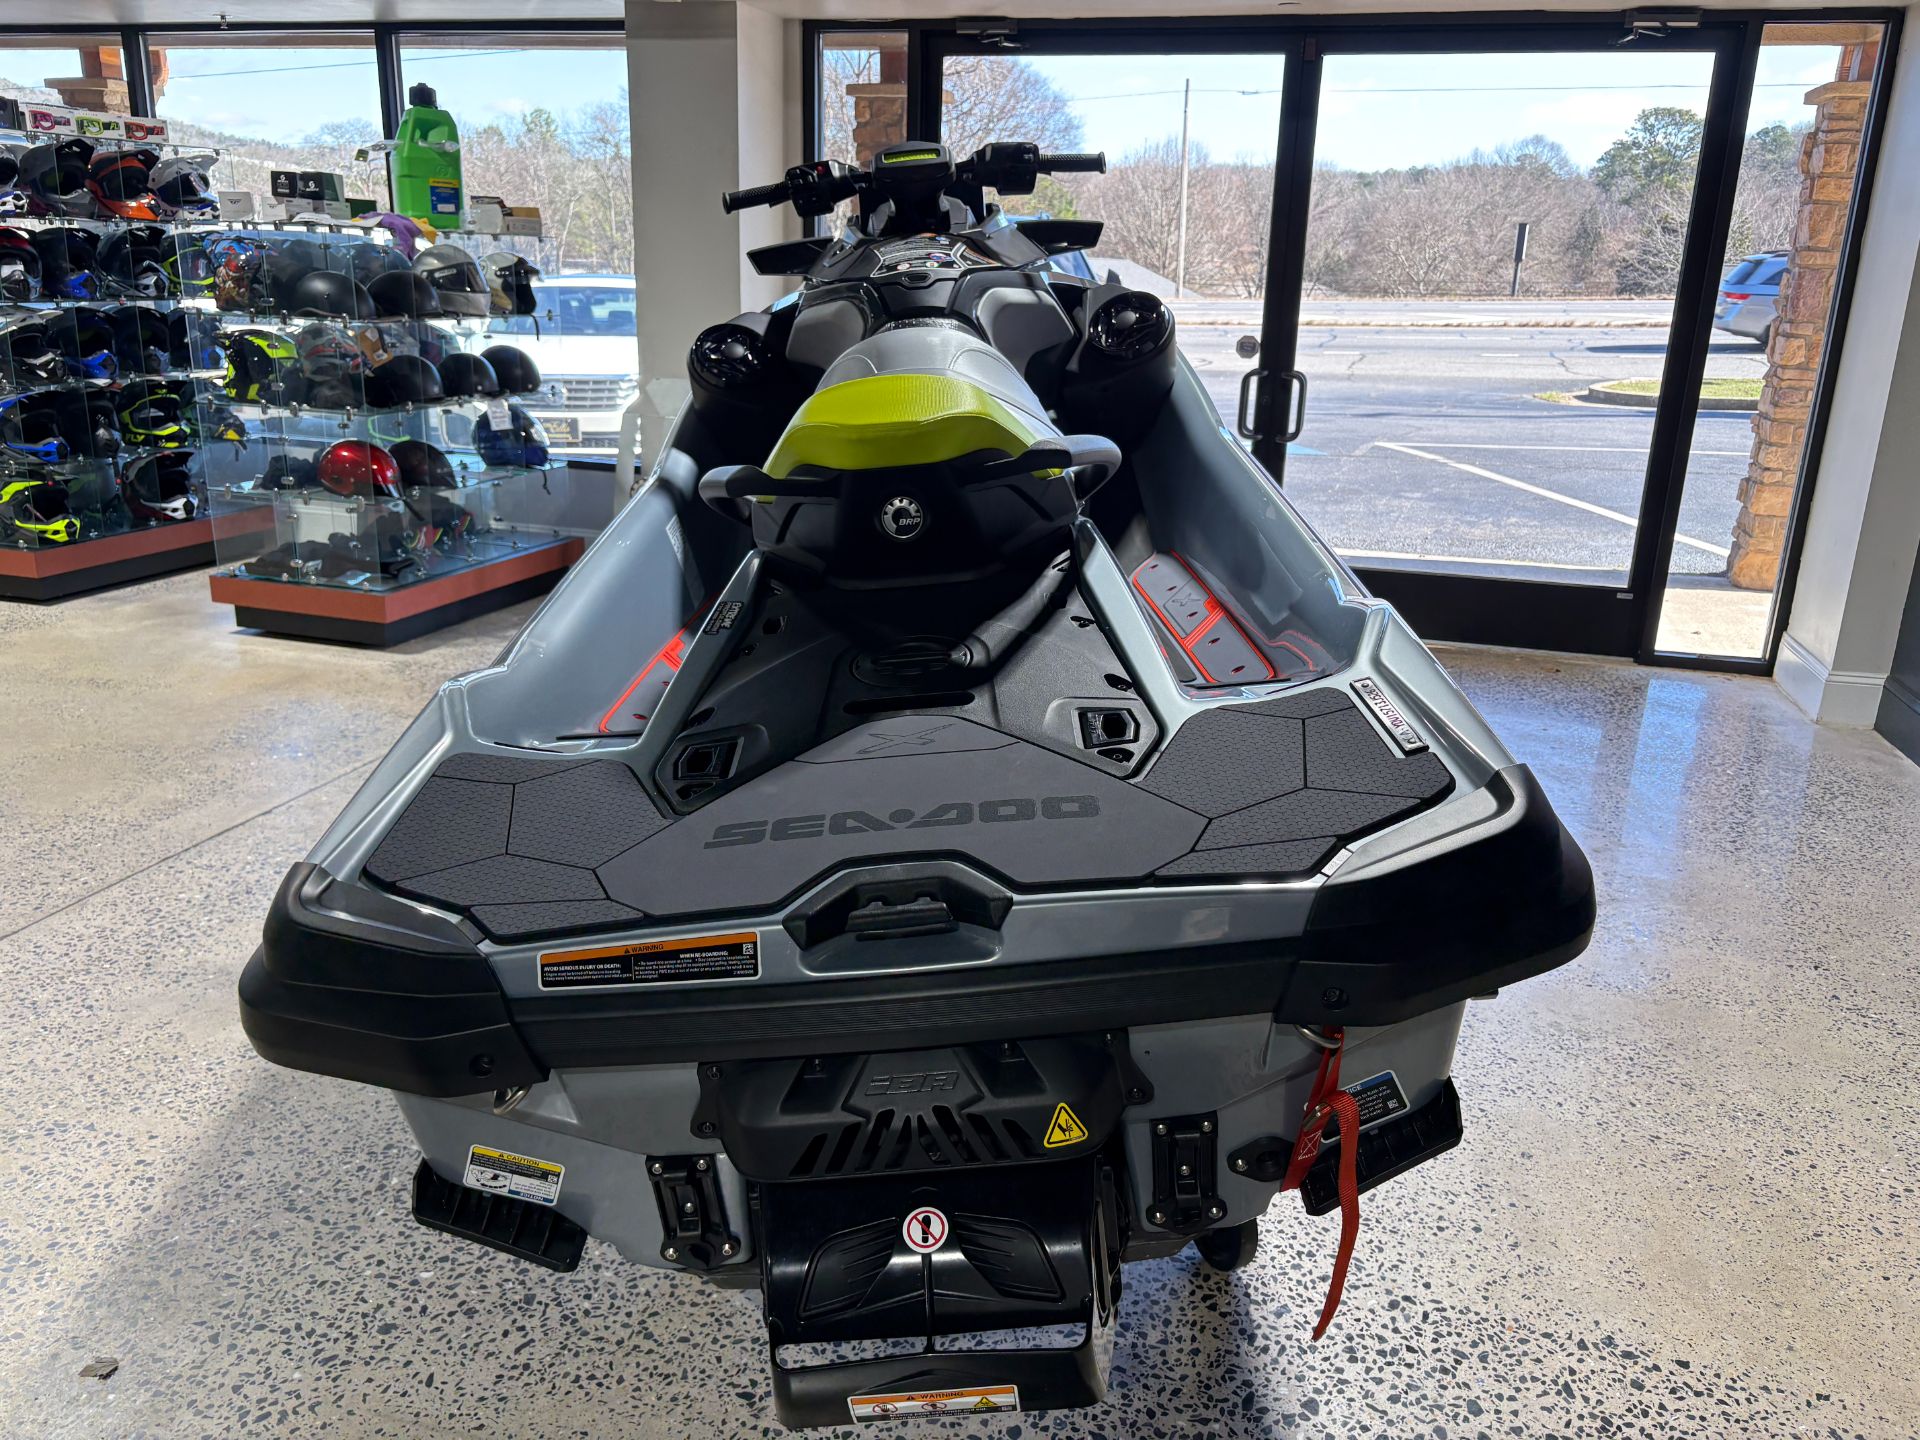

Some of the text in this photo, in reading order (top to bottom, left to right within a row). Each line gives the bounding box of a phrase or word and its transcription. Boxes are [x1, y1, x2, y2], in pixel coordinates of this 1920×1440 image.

[898, 517, 921, 526] BRP
[631, 944, 664, 953] WARNING
[506, 1153, 540, 1167] CAUTION
[920, 1391, 964, 1400] WARNING
